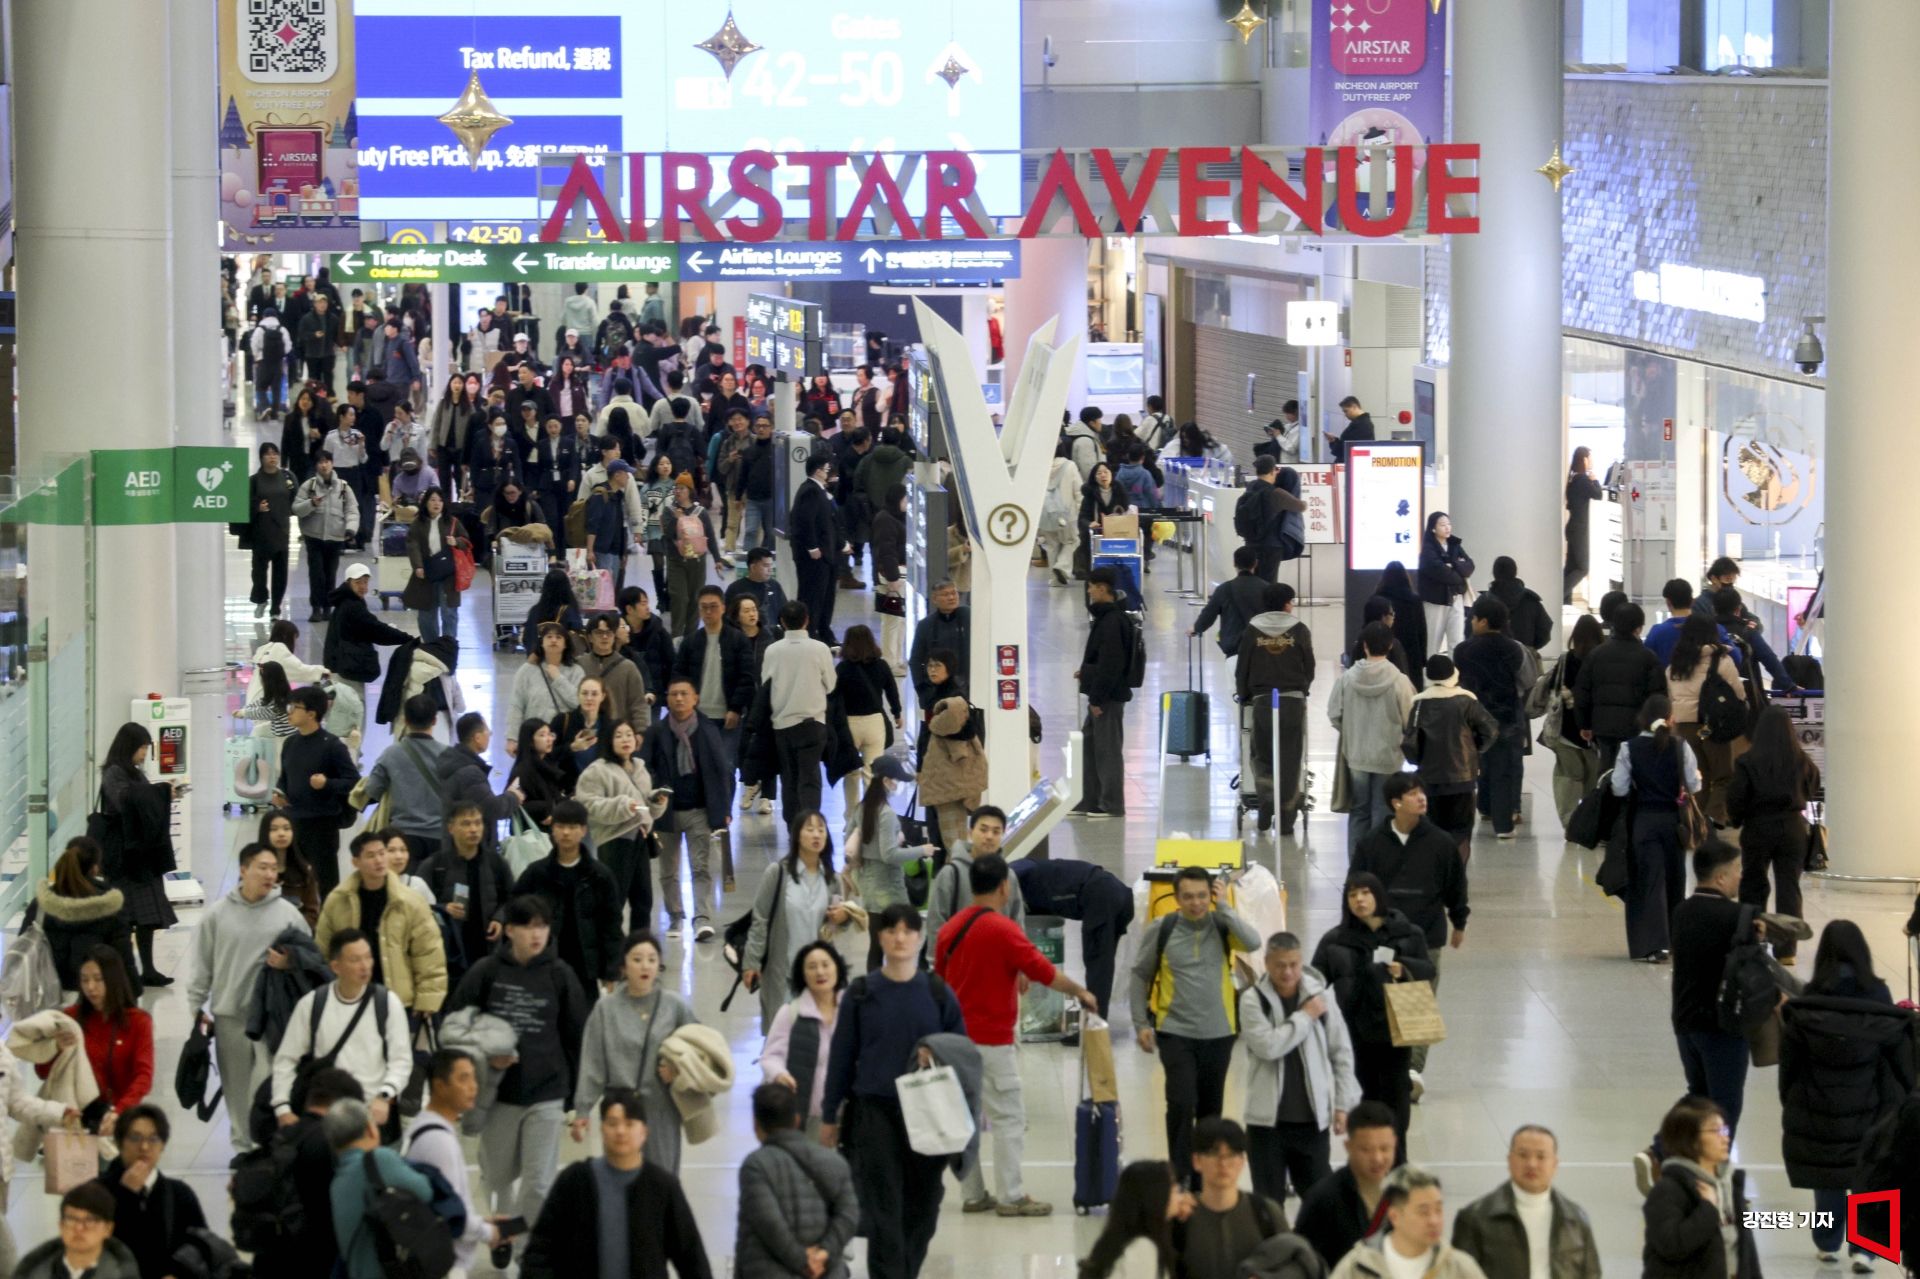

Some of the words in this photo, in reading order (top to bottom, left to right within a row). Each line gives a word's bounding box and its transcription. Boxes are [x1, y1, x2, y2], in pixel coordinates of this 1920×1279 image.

[832, 13, 901, 39] Gates
[1344, 40, 1410, 54] AIRSTAR
[459, 47, 494, 69] Tax
[497, 45, 571, 70] Refund,
[742, 51, 904, 107] 42-50
[1335, 82, 1377, 90] INCHEON
[1379, 82, 1419, 90] AIRPORT
[279, 153, 318, 162] AIRSTAR
[358, 146, 389, 171] uty
[390, 146, 431, 166] Free
[539, 149, 989, 243] AIRSTAR
[1018, 144, 1480, 239] AVENUE
[467, 226, 521, 244] 42-50
[369, 248, 442, 266] Transfer
[444, 248, 487, 266] Desk
[544, 251, 609, 270] Transfer
[611, 253, 672, 274] Lounge
[719, 247, 774, 265] Airline
[775, 248, 843, 267] Lounges
[1371, 457, 1417, 468] PROMOTION
[125, 471, 161, 488] AED
[1300, 472, 1327, 486] ALE
[192, 495, 228, 508] AED
[163, 728, 183, 738] AED
